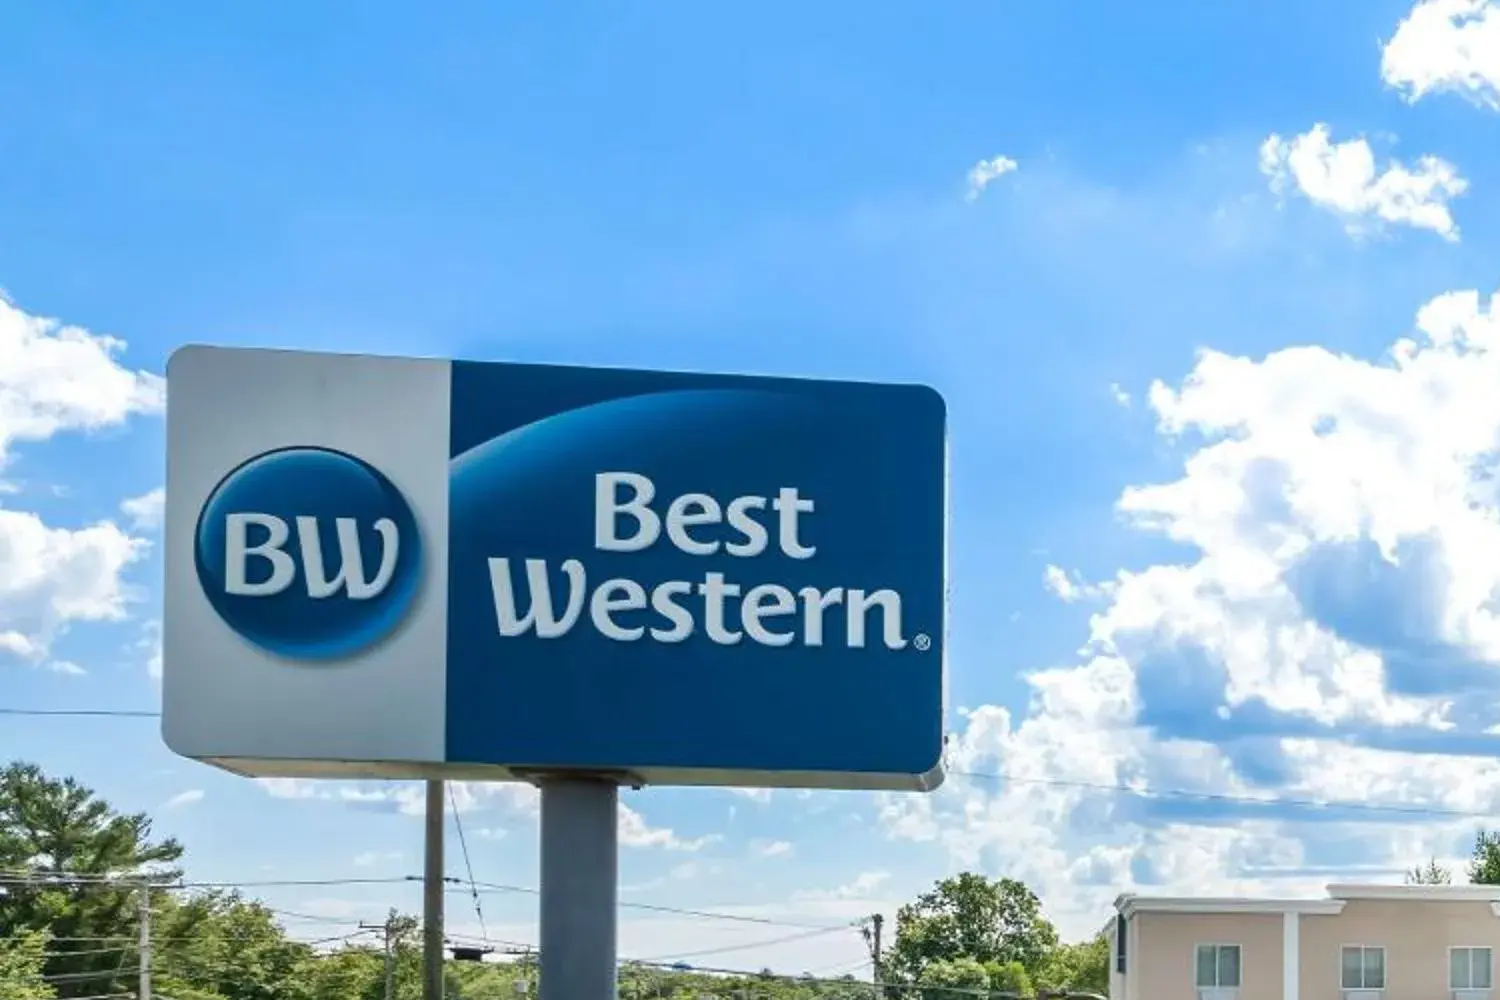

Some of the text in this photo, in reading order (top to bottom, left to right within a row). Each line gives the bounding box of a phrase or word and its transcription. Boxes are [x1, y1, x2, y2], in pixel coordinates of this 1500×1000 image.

[224, 513, 400, 600] BW
[595, 471, 817, 559] Best
[487, 556, 908, 650] Western
